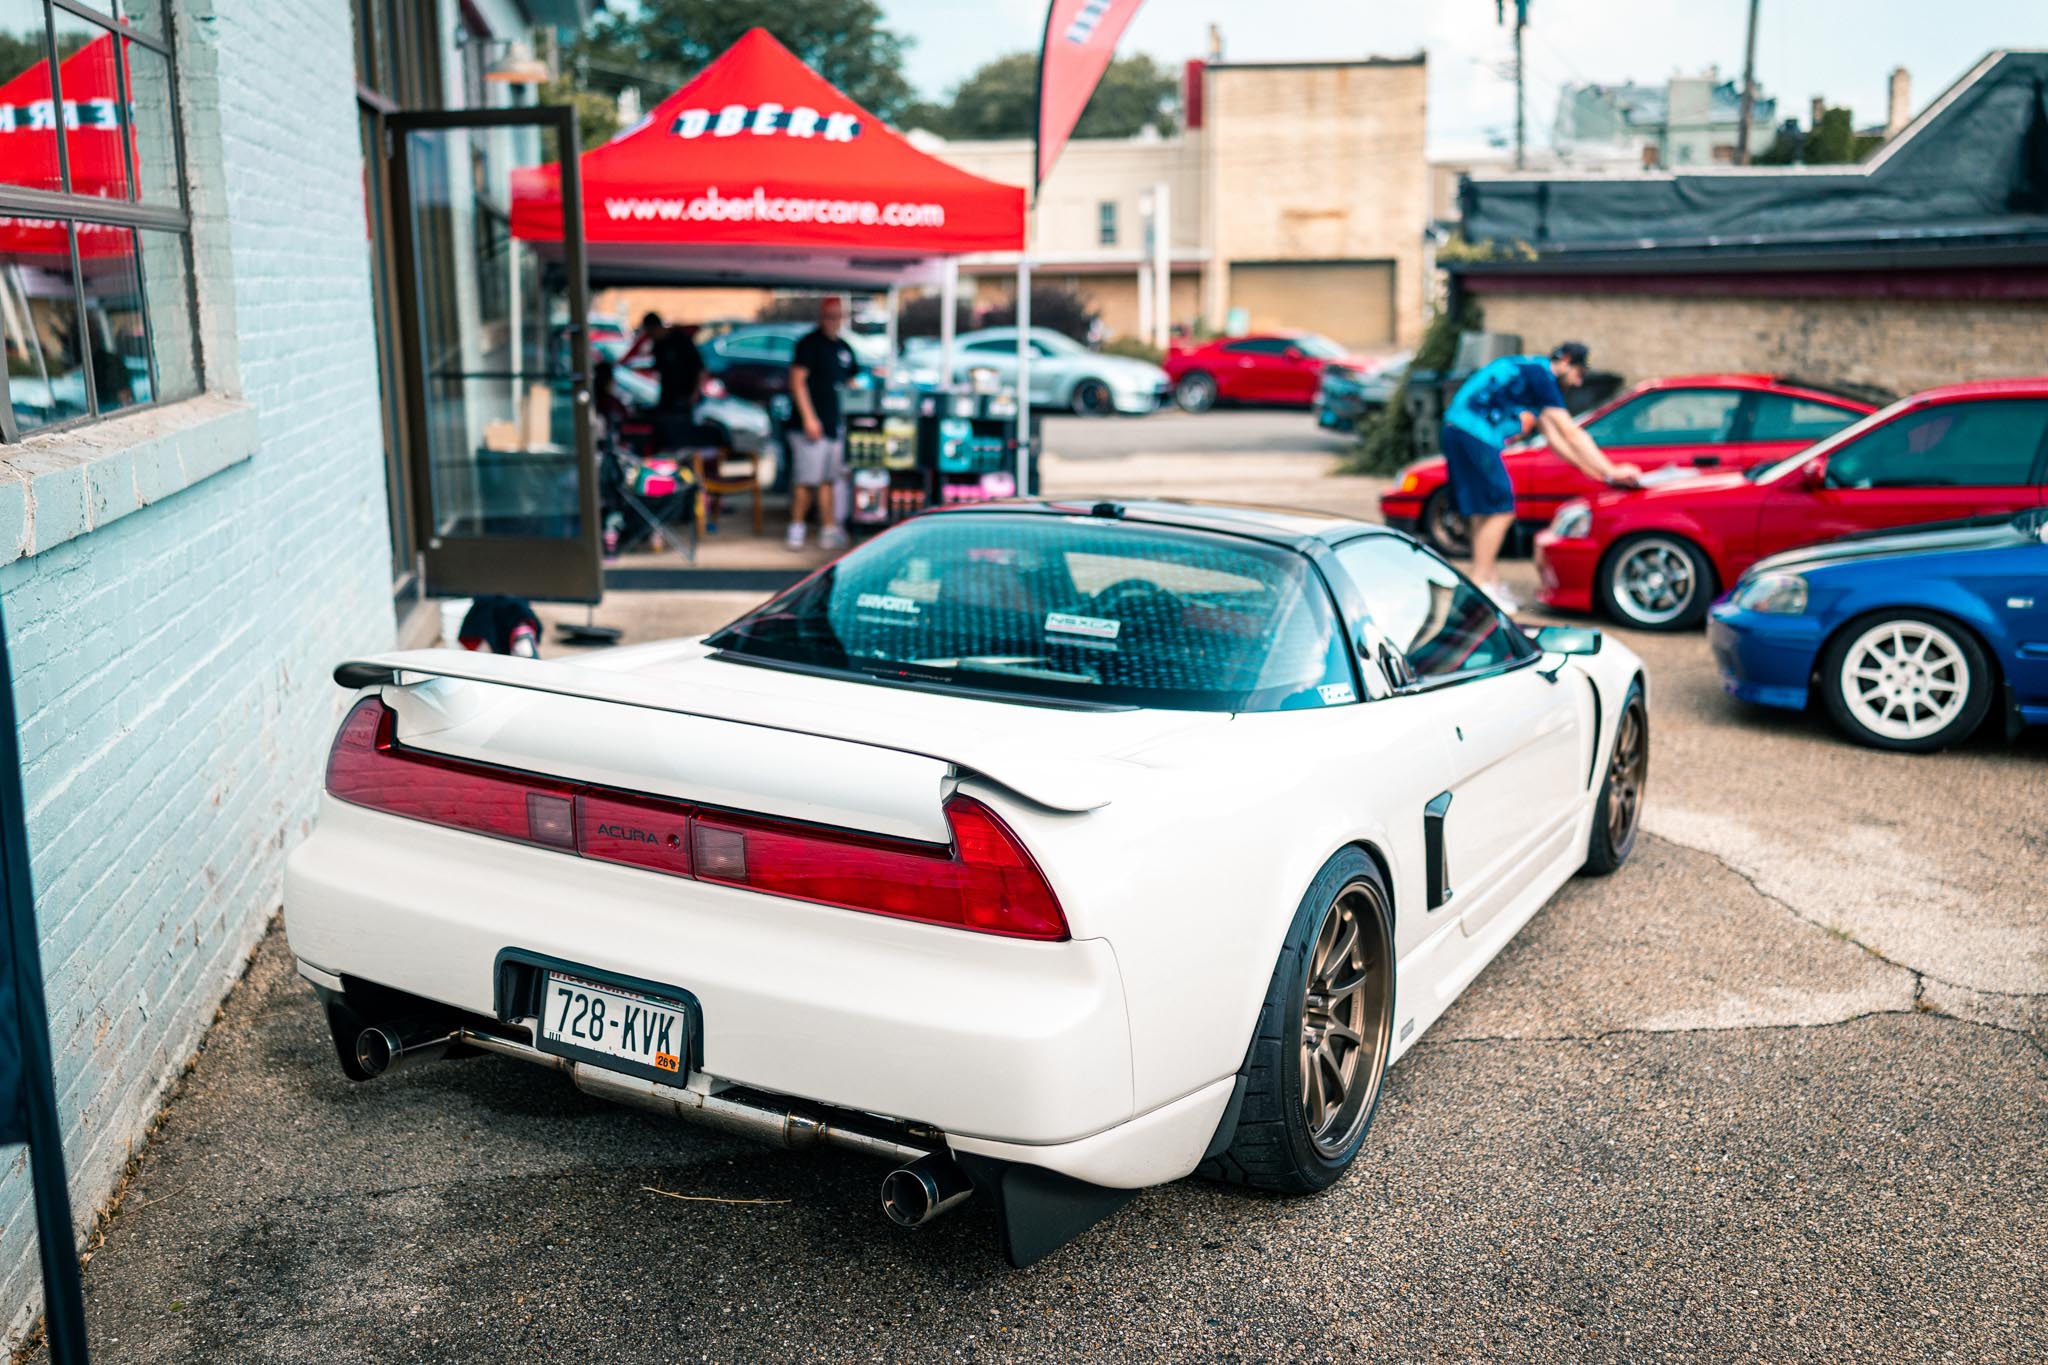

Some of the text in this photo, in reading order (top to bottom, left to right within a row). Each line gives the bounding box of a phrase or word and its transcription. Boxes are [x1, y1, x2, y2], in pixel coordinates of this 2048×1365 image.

[678, 102, 858, 142] OBERK
[604, 186, 945, 227] www.oberkcarcare.com
[597, 823, 659, 846] ACURA
[557, 987, 675, 1056] 728-KVK
[657, 1055, 669, 1068] 26
